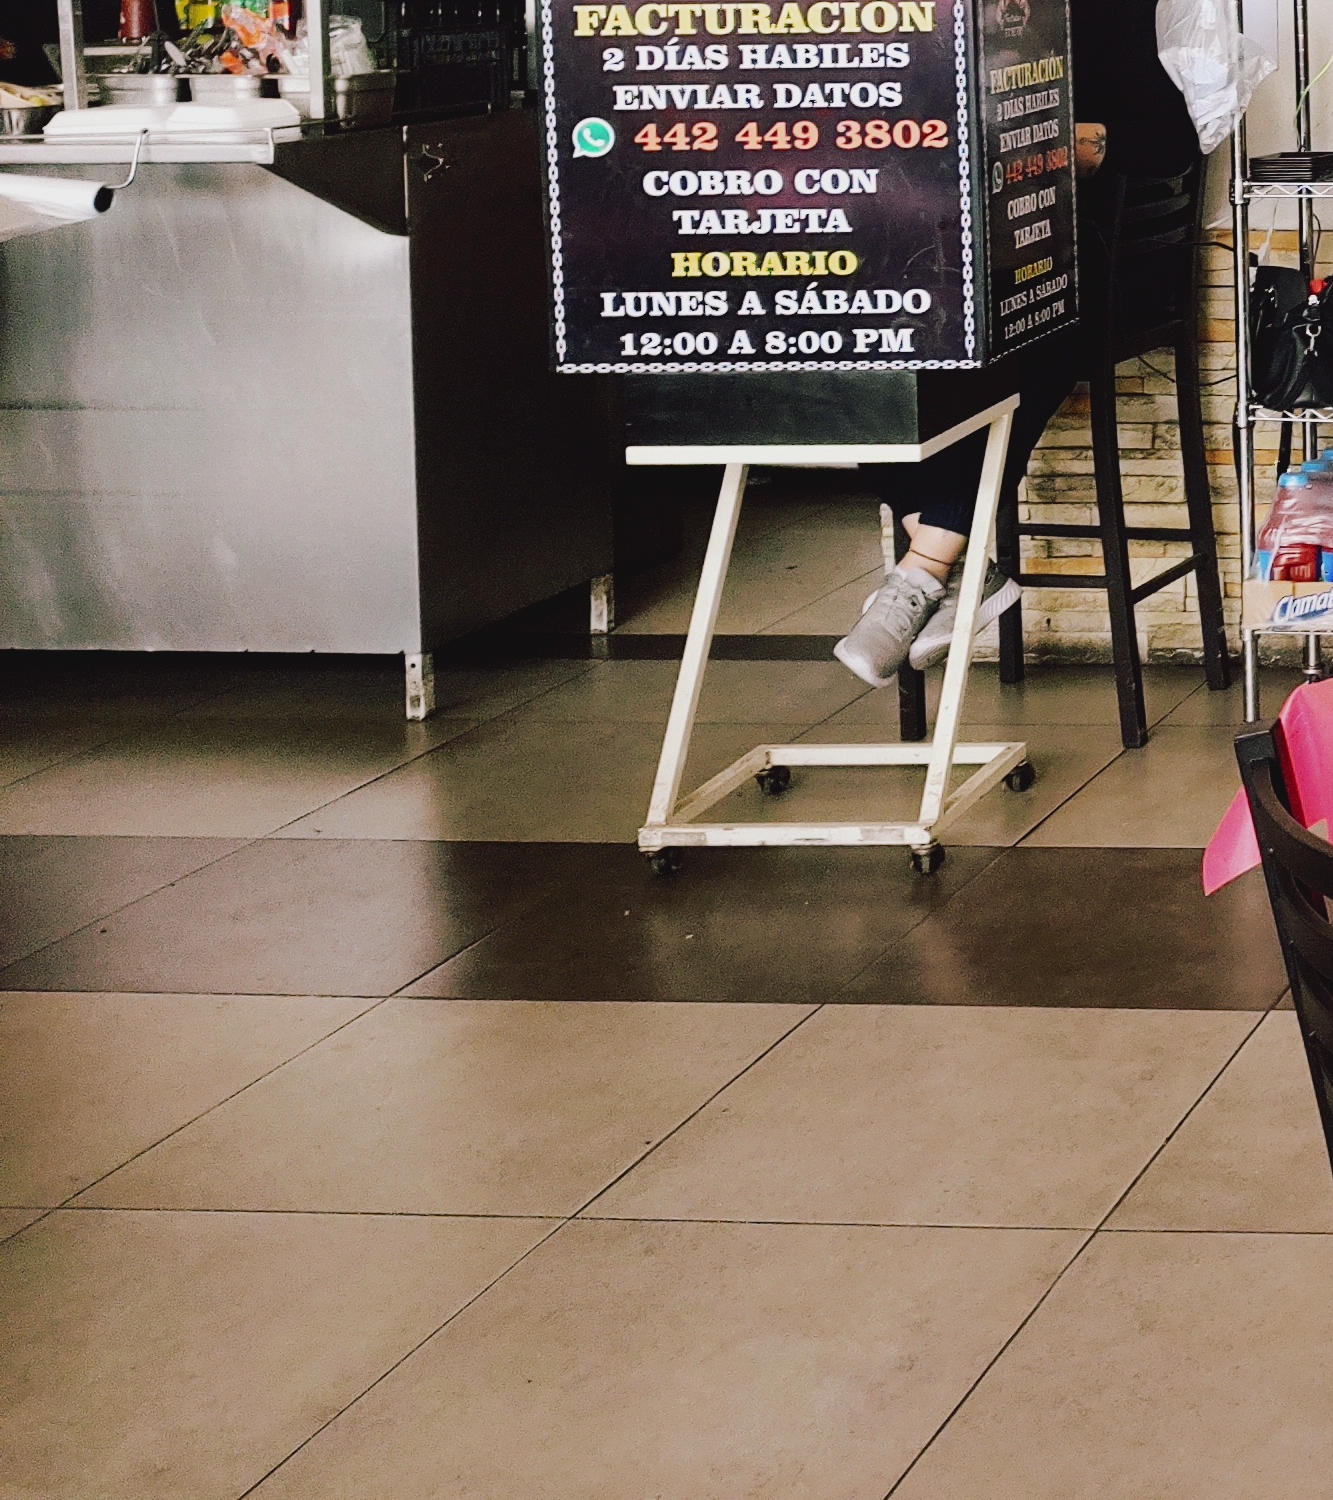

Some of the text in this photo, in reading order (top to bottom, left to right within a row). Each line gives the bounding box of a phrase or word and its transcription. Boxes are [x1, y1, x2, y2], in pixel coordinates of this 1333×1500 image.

[602, 38, 910, 71] 2 DÍAS HABILES
[990, 49, 1063, 94] FACTURACIÓN
[613, 82, 902, 110] ENVIAR DATOS
[634, 119, 949, 151] 442 449 3802
[1000, 119, 1059, 152] ENVIAR DATOS
[642, 168, 879, 196] COBRO CON
[1008, 186, 1056, 221] COBRO CON
[672, 208, 852, 235] TARJETA
[1014, 219, 1051, 249] TARJETA
[671, 250, 858, 278] HORARIO
[1015, 257, 1053, 284] HORARIO
[600, 282, 932, 317] LUNES A SÁBADO
[619, 328, 915, 356] 12:00 A 8:00 PM
